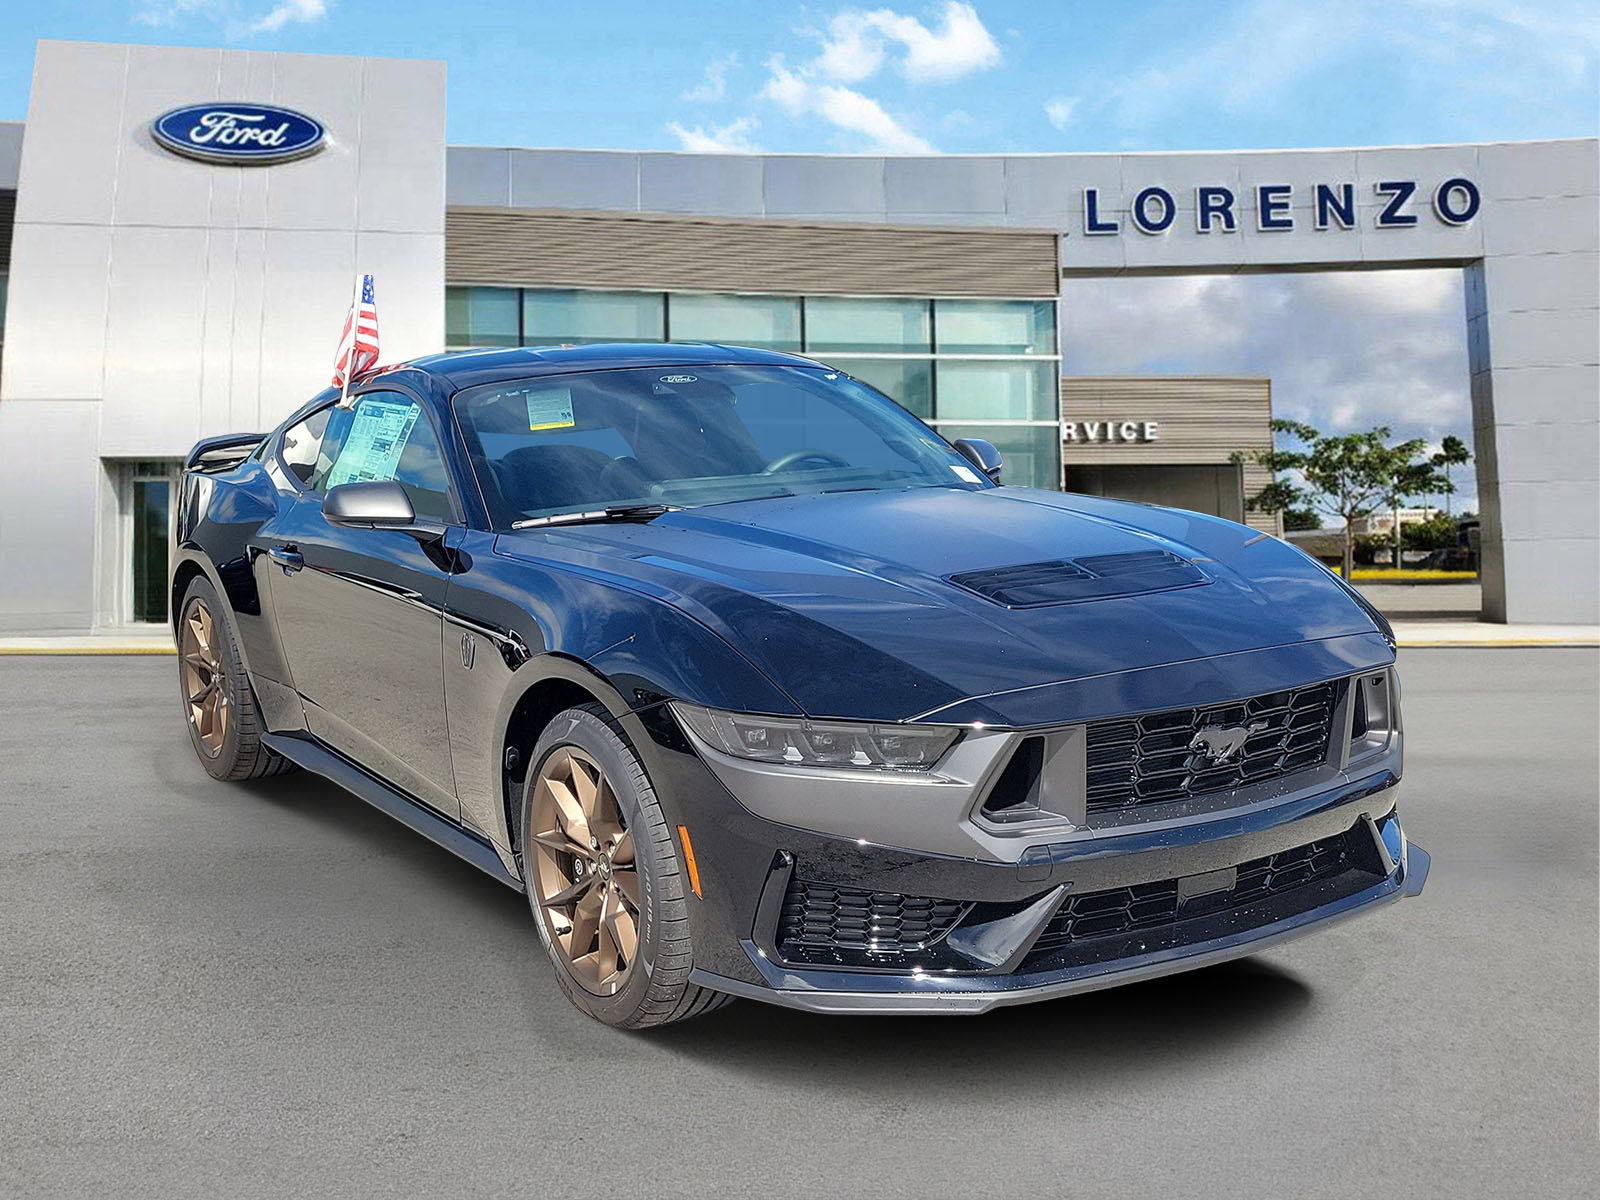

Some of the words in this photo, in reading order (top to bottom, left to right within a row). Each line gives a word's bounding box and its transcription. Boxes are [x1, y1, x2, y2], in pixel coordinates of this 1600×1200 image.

[190, 111, 290, 146] Ford
[1084, 177, 1481, 236] LORENZO
[1061, 420, 1159, 440] RVICE
